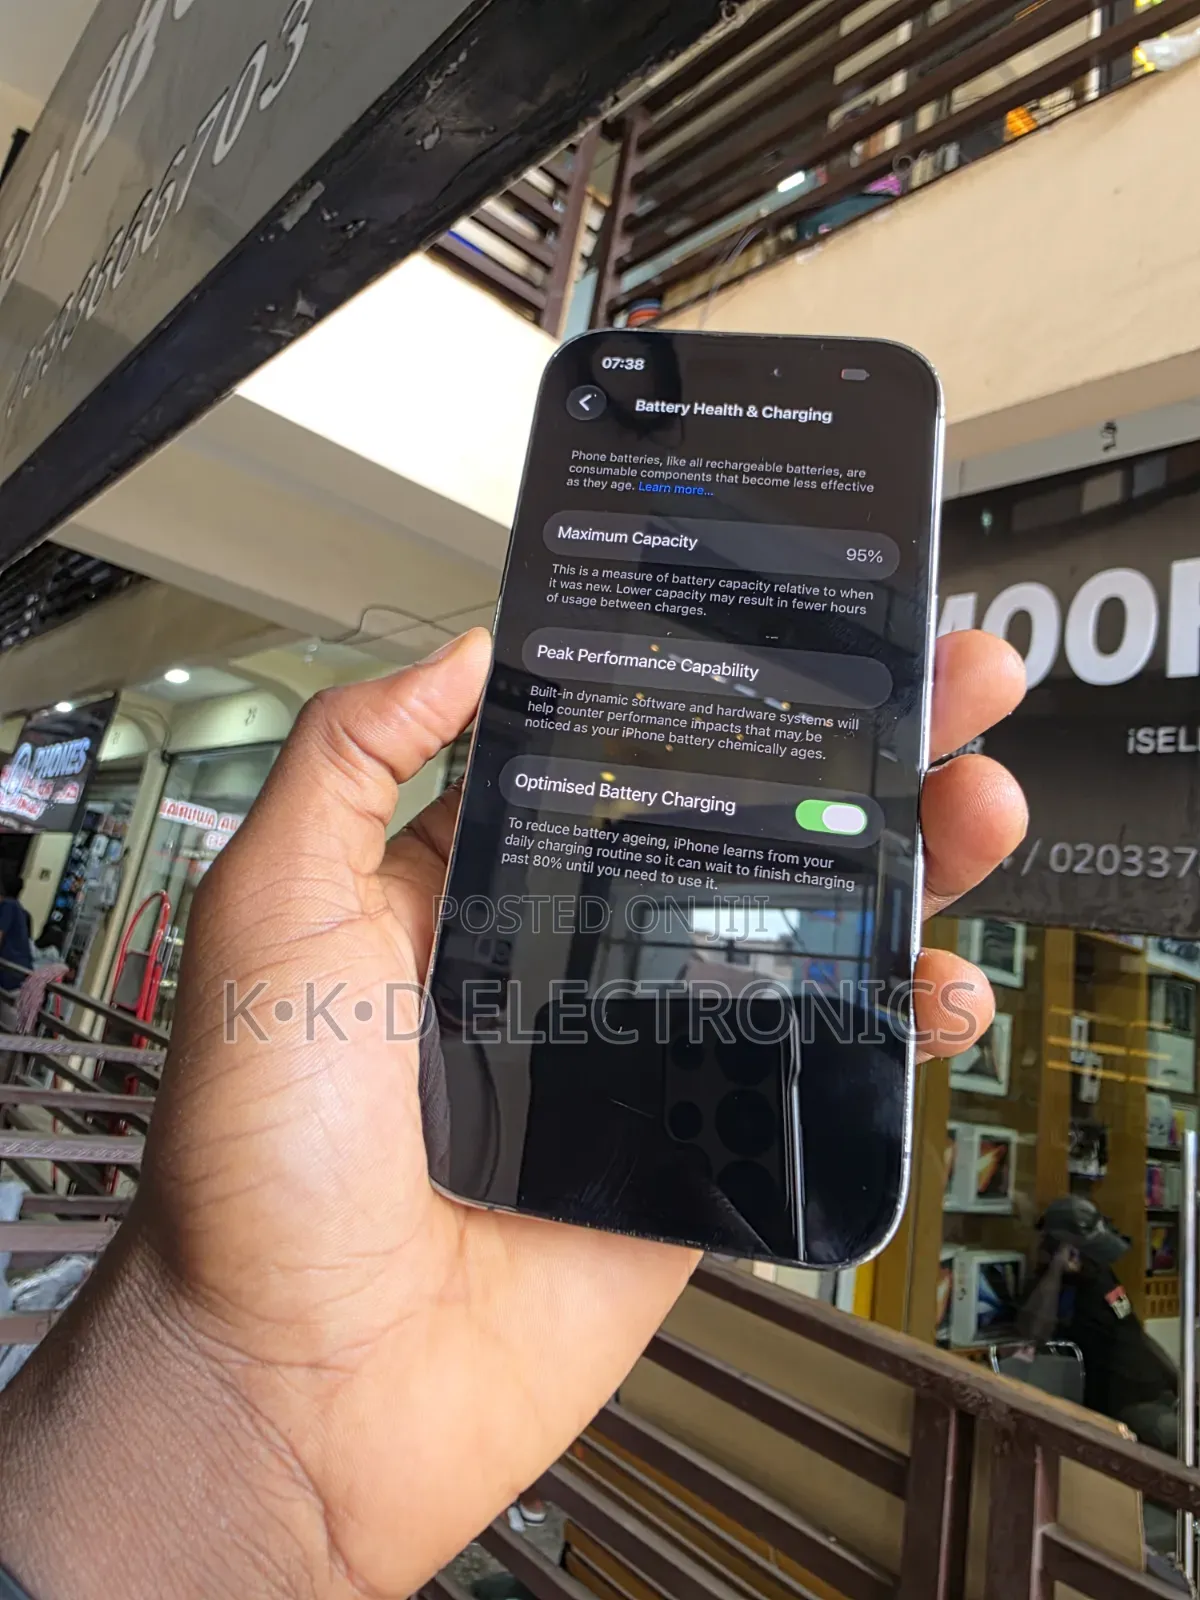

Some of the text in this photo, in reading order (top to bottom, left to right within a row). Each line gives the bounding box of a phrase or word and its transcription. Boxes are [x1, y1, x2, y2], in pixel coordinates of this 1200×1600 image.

[601, 356, 645, 371] 07:38
[635, 398, 833, 424] Battery Health & Charging
[568, 464, 875, 493] consumable components that become less effective
[571, 449, 866, 479] Phone batteries, like all rechargeable batteries, are
[566, 478, 581, 488] as
[583, 477, 608, 491] they
[610, 481, 635, 492] age.
[638, 481, 671, 493] Learn
[558, 526, 698, 551] Maximum Capacity
[846, 548, 883, 563] 95%
[549, 578, 867, 615] it was new. Lower capacity may result in fewer hours
[552, 563, 874, 600] This is a measure of battery capacity relative to when
[546, 592, 706, 616] of usage between charges.
[537, 644, 759, 682] Peak Performance Capability
[527, 701, 822, 742] help counter performance impacts that may be
[530, 685, 859, 731] Built-in dynamic software and hardware systems will
[525, 718, 826, 760] noticed as your iPhone battery chemically ages.
[1127, 726, 1200, 755] iSEL
[515, 773, 736, 816] Optimised Battery Charging
[508, 817, 834, 869] To reduce battery ageing, iPhone learns from your
[1049, 841, 1200, 879] 020337
[502, 852, 718, 890] past 80% until you need to use it.
[505, 834, 855, 892] daily charging routine so it can wait to finish charging
